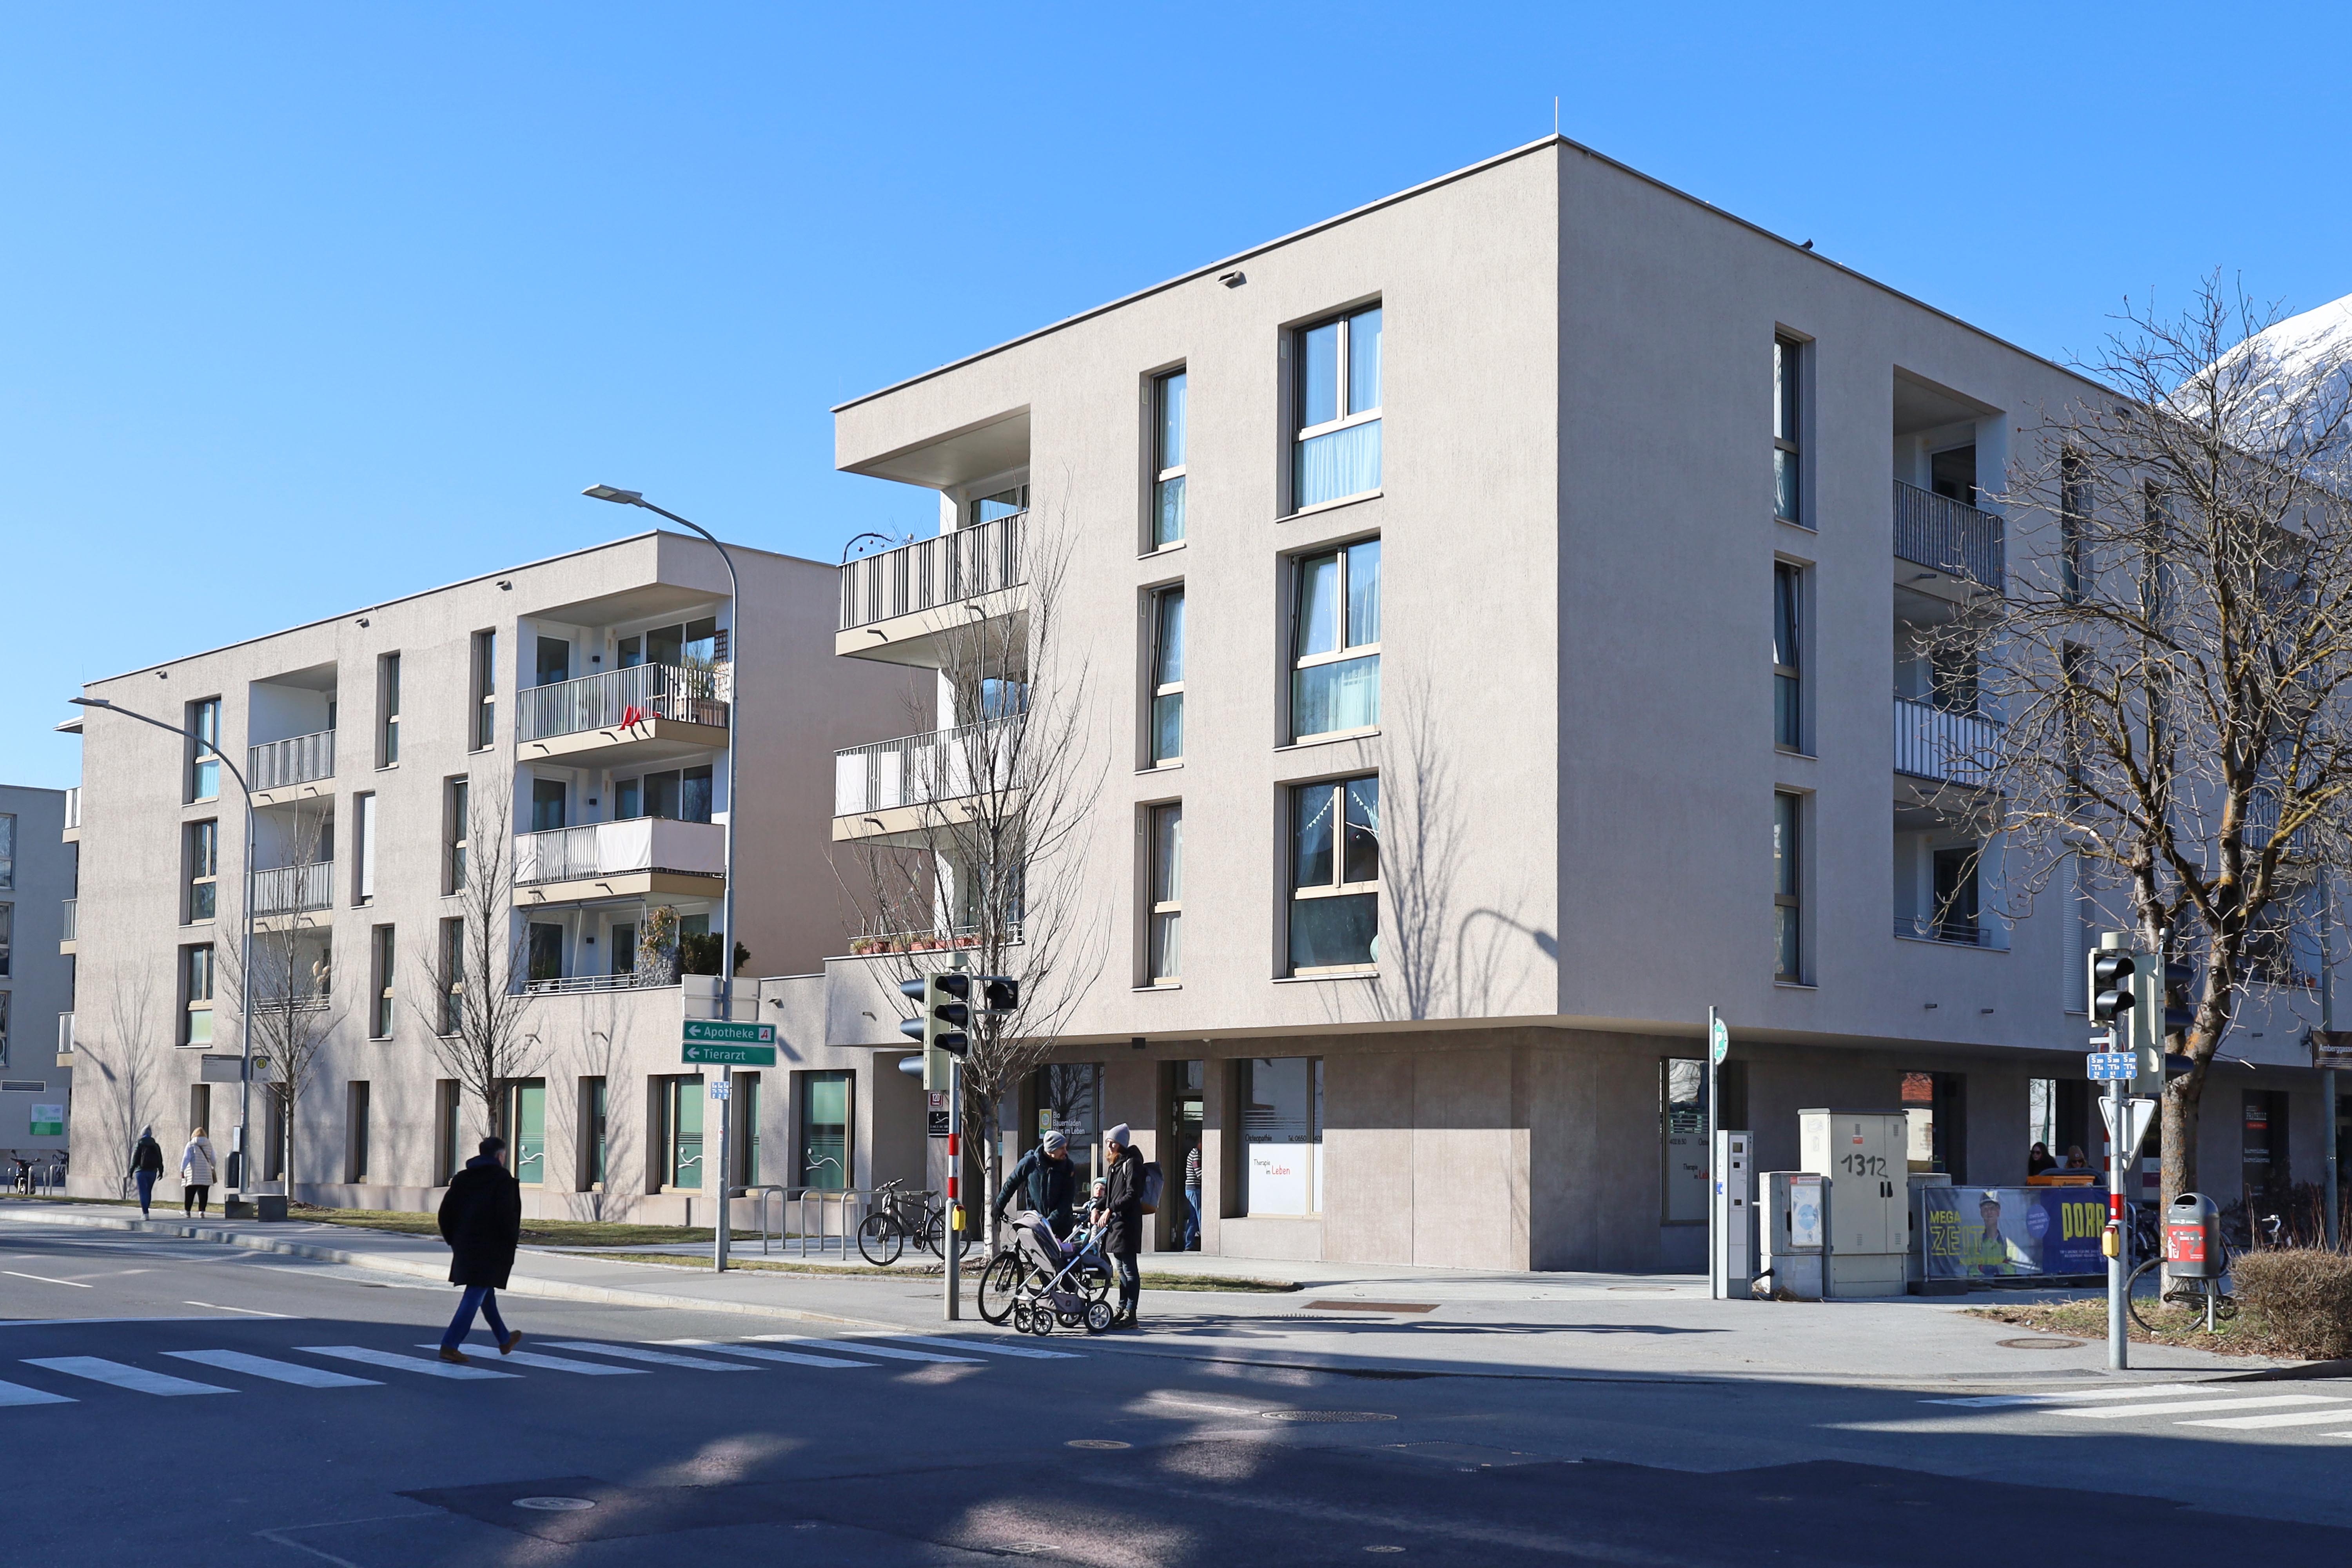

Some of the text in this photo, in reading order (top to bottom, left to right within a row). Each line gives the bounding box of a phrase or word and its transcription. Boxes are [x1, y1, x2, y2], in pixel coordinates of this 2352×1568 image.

[704, 1026, 754, 1038] Apotheke
[704, 1049, 746, 1060] Tierarzt
[1245, 1134, 1272, 1143] Osteopathie
[1254, 1159, 1270, 1167] Therapie
[1841, 1154, 1888, 1178] 1312
[1272, 1165, 1290, 1175] Leben
[1930, 1210, 1962, 1223] MEGA
[2062, 1203, 2105, 1241] PORR
[1930, 1225, 1985, 1256] ZEIT
